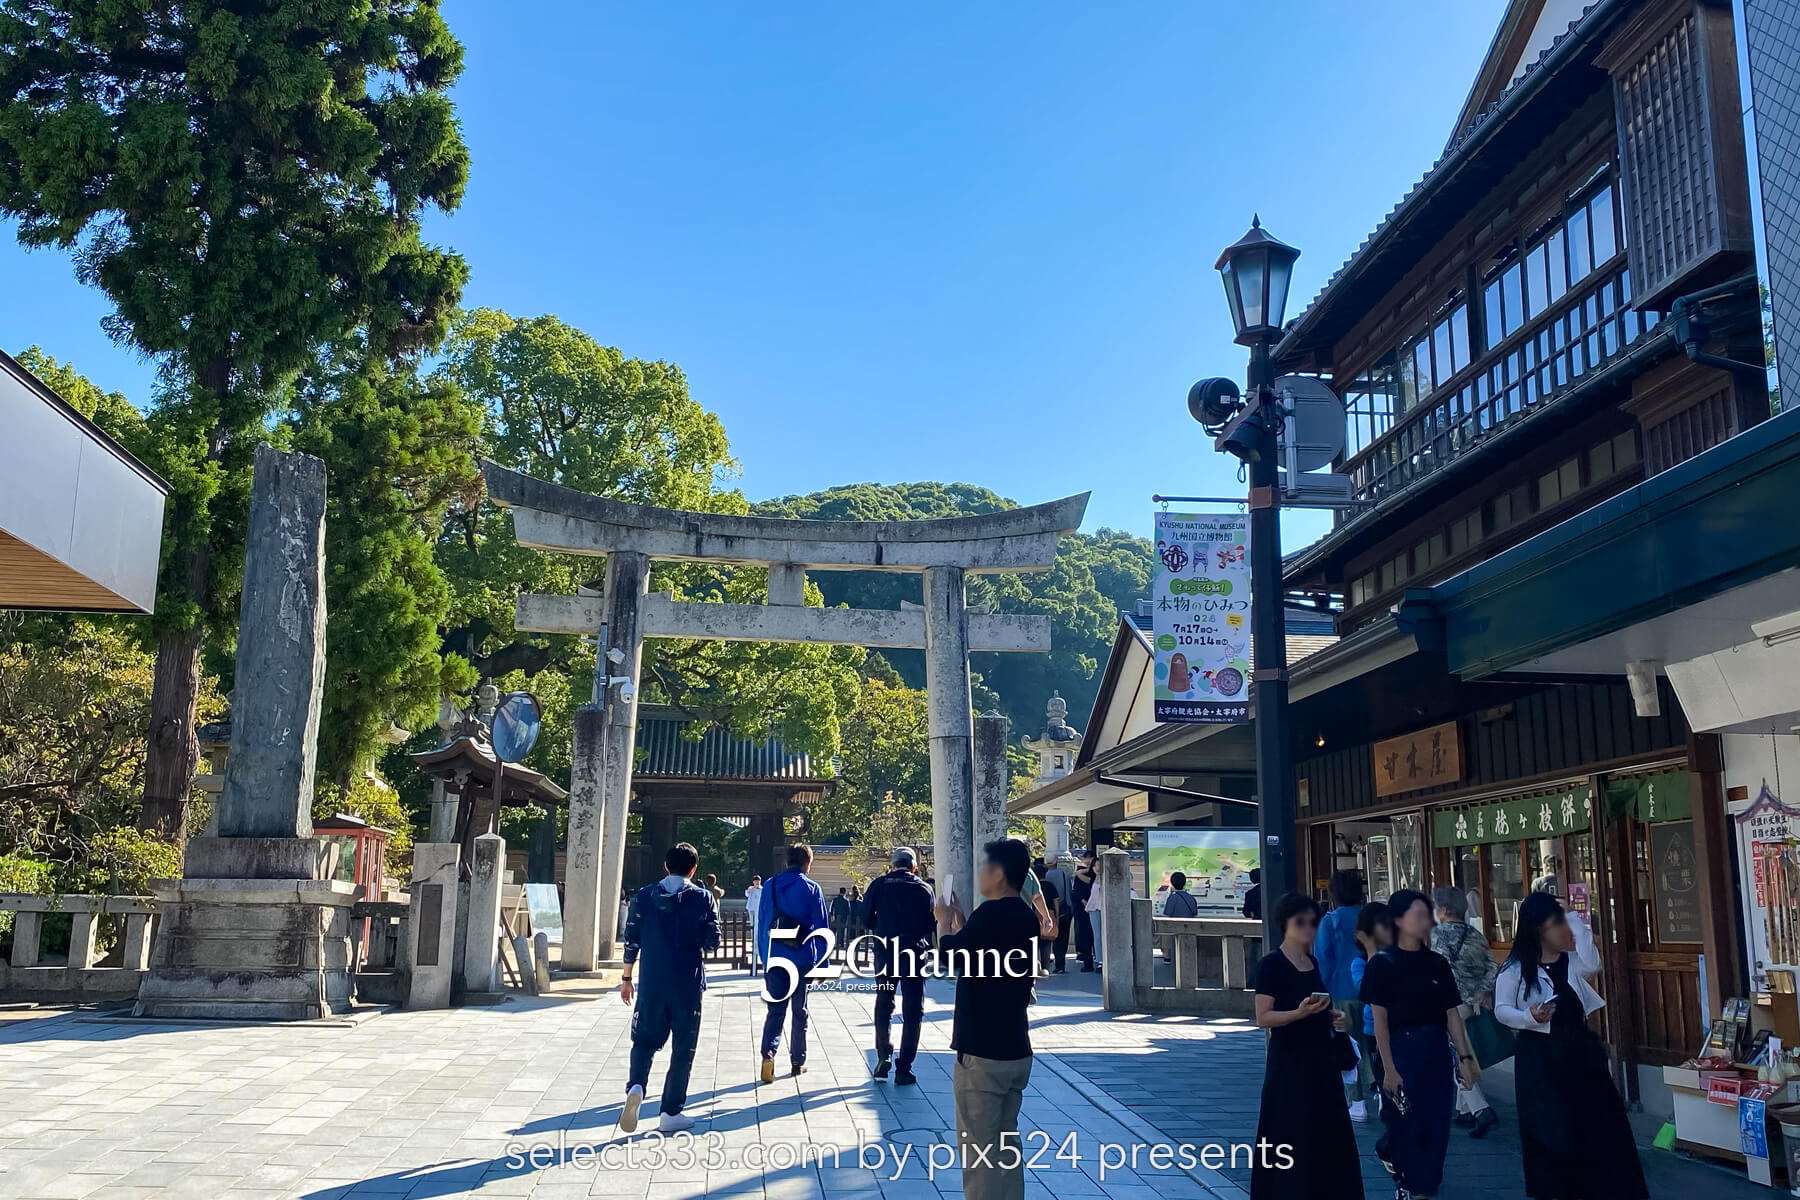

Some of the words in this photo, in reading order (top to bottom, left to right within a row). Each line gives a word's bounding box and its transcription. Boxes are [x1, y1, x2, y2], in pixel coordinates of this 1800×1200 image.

[1159, 521, 1184, 529] KYUSHU
[1185, 522, 1218, 530] NATIONAL
[1219, 522, 1246, 530] MUSEUM
[1170, 531, 1233, 542] 九州国立博物館
[1157, 595, 1249, 612] 本物のひみつ
